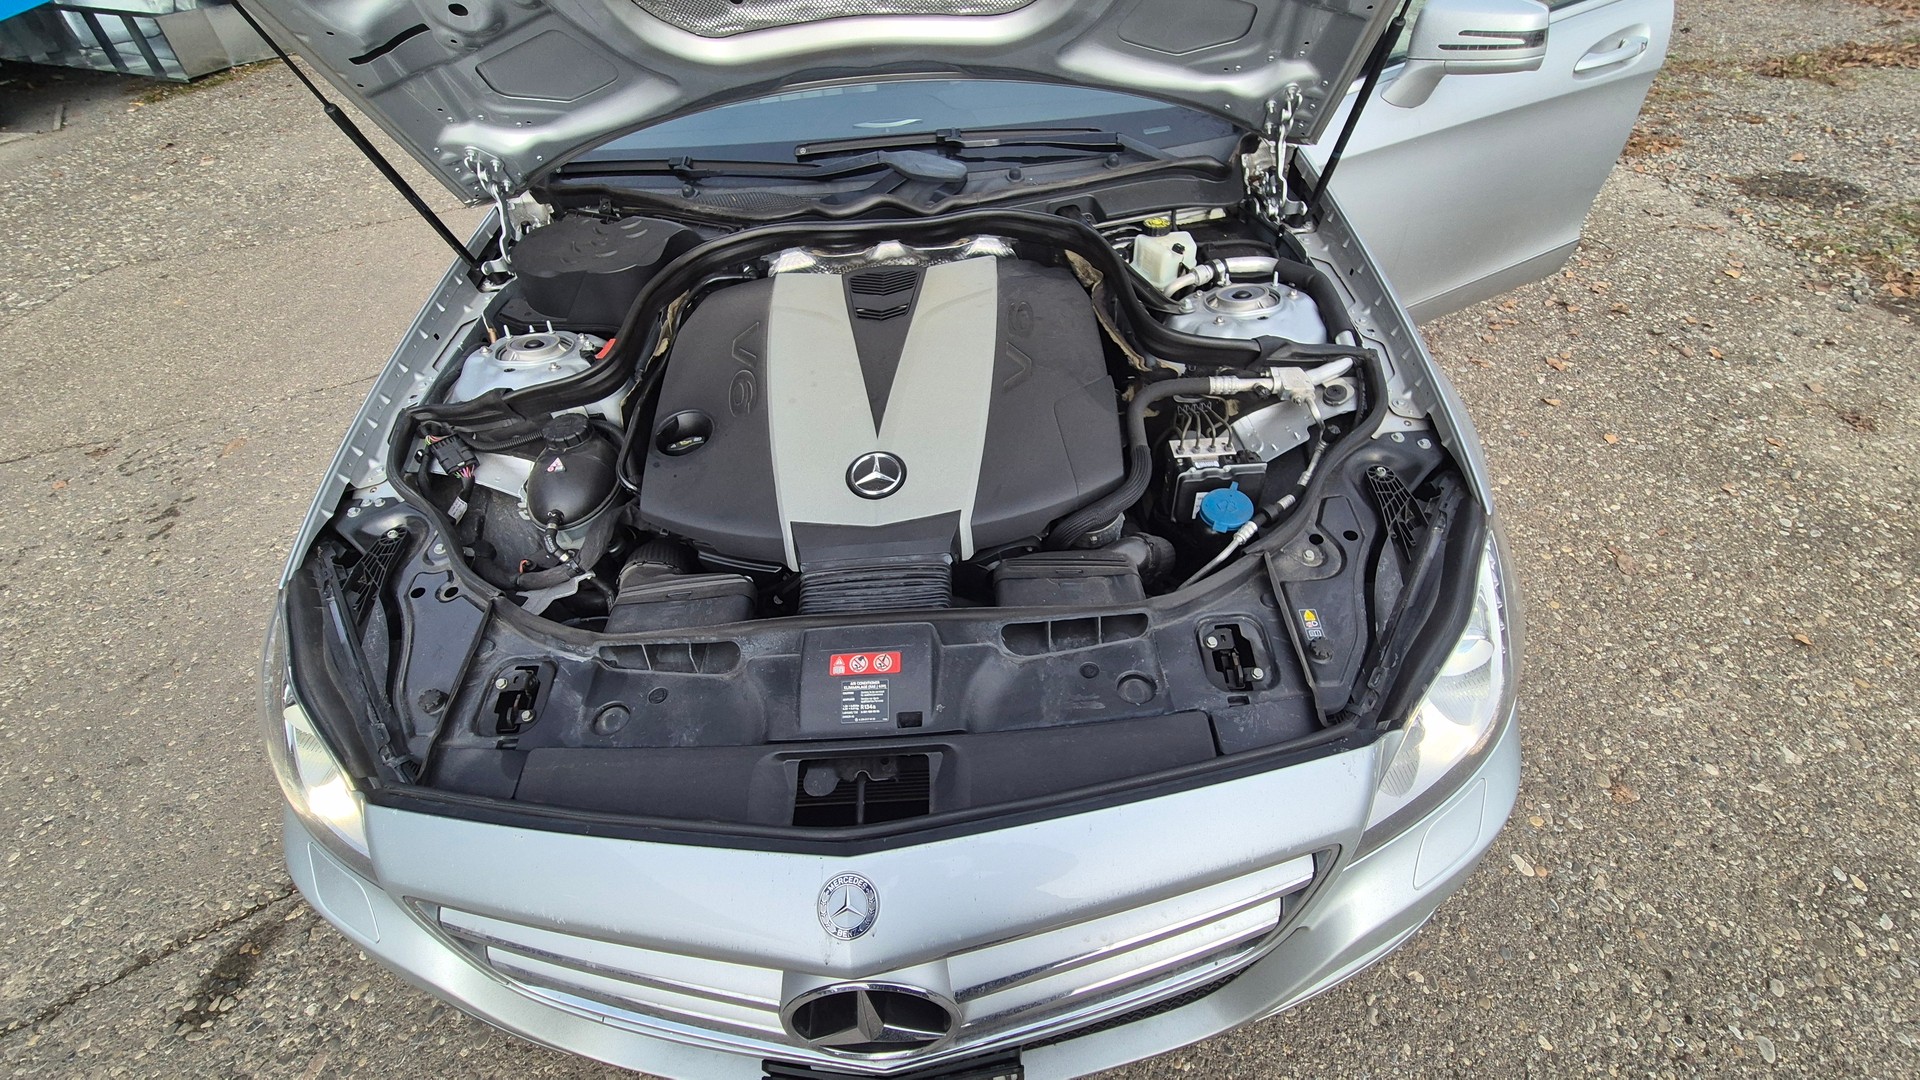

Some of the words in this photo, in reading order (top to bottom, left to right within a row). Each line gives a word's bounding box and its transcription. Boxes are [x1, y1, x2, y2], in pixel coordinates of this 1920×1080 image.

[728, 321, 760, 417] V6
[1003, 301, 1034, 389] V6
[828, 876, 868, 892] MERCEDES
